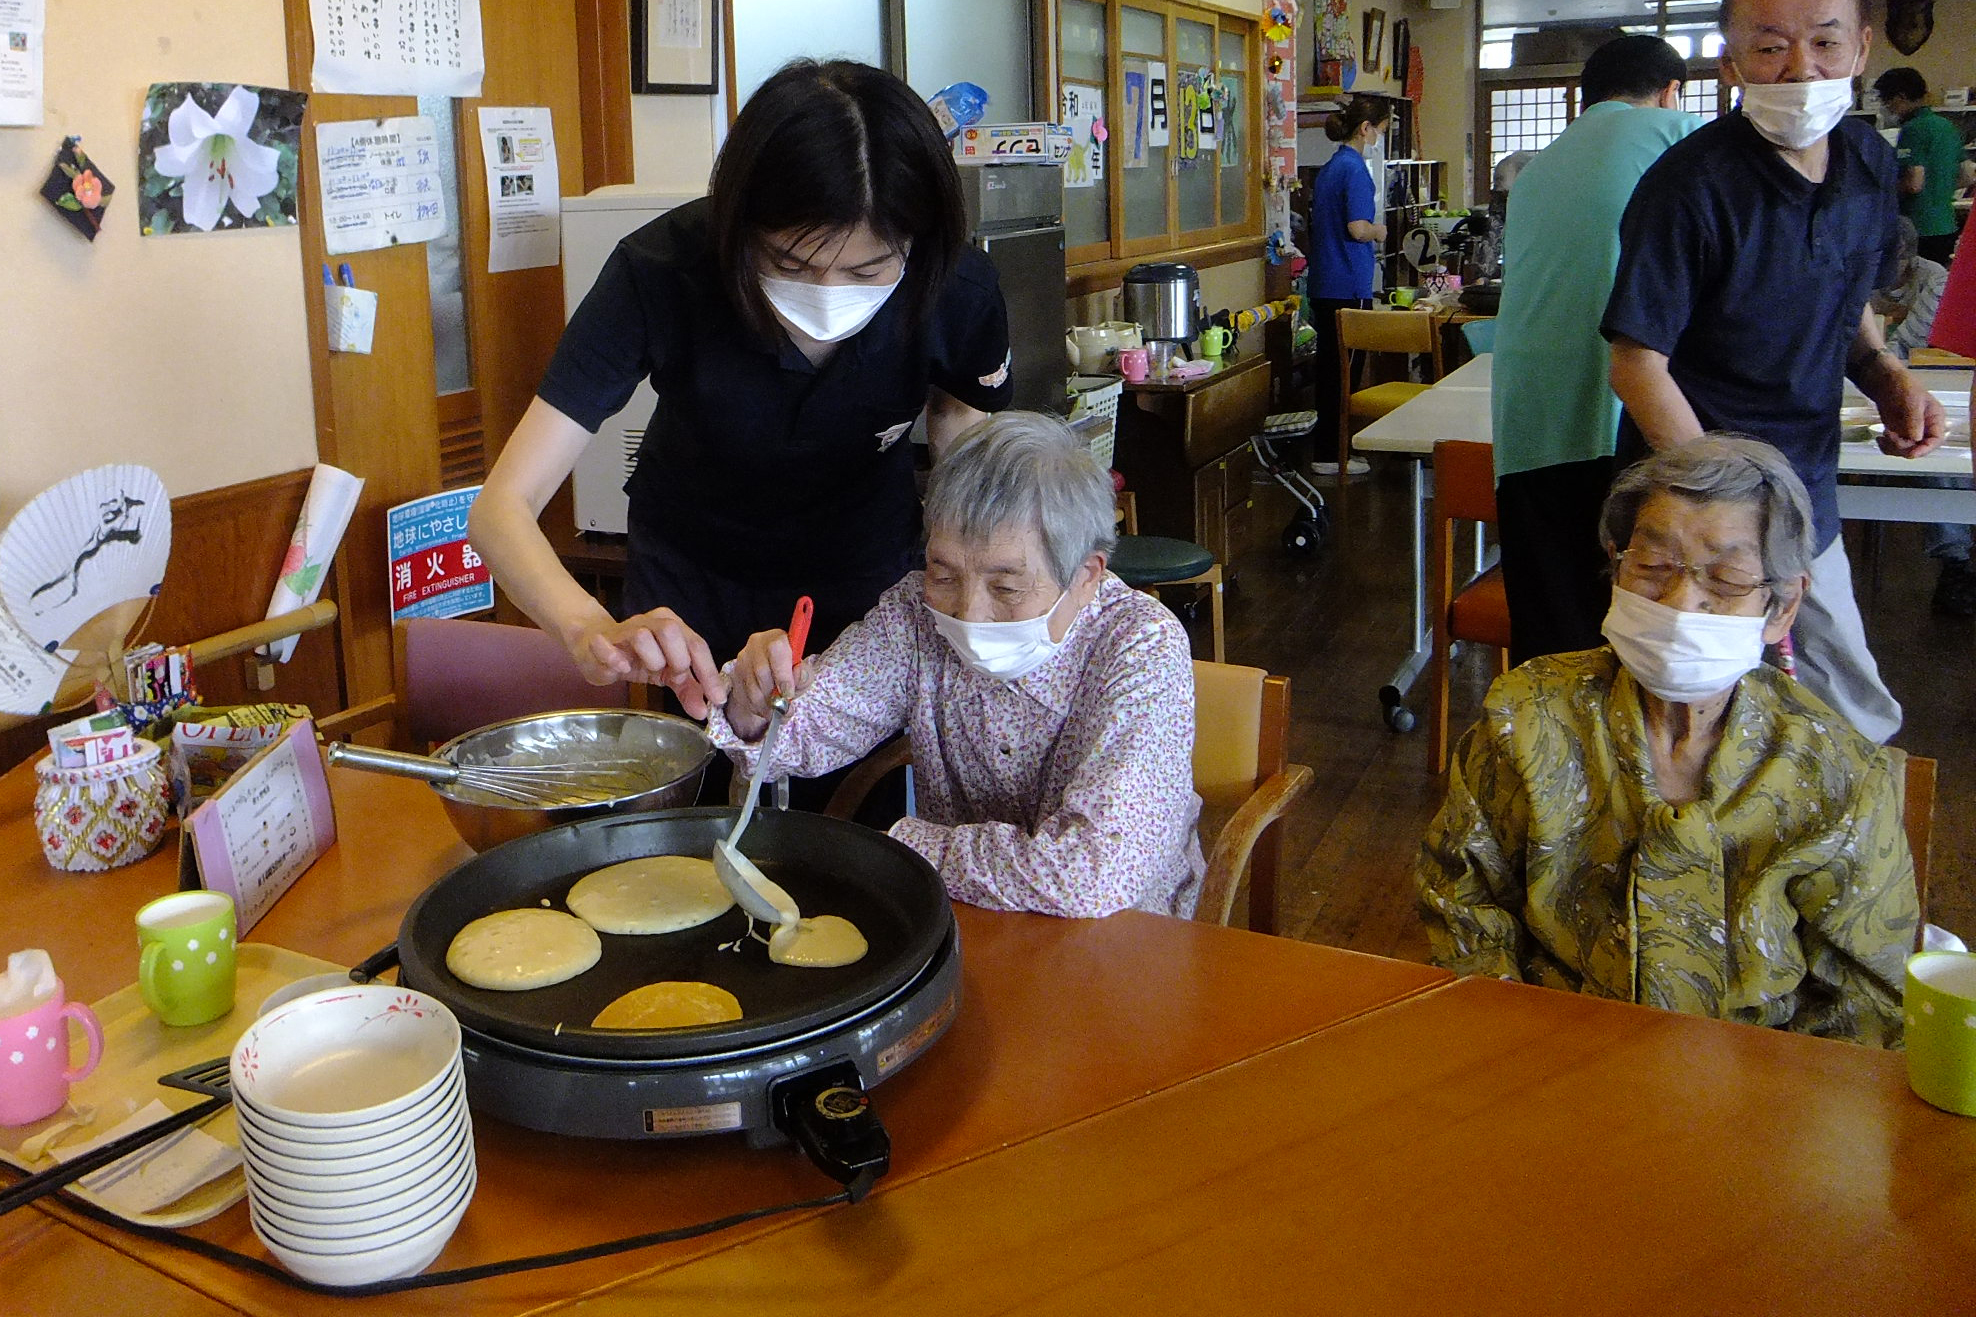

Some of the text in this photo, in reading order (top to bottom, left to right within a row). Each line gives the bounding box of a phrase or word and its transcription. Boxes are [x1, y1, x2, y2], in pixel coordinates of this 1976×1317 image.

[1411, 229, 1437, 266] 2
[403, 589, 418, 604] FIRE
[421, 572, 476, 597] EXTINGUISHER
